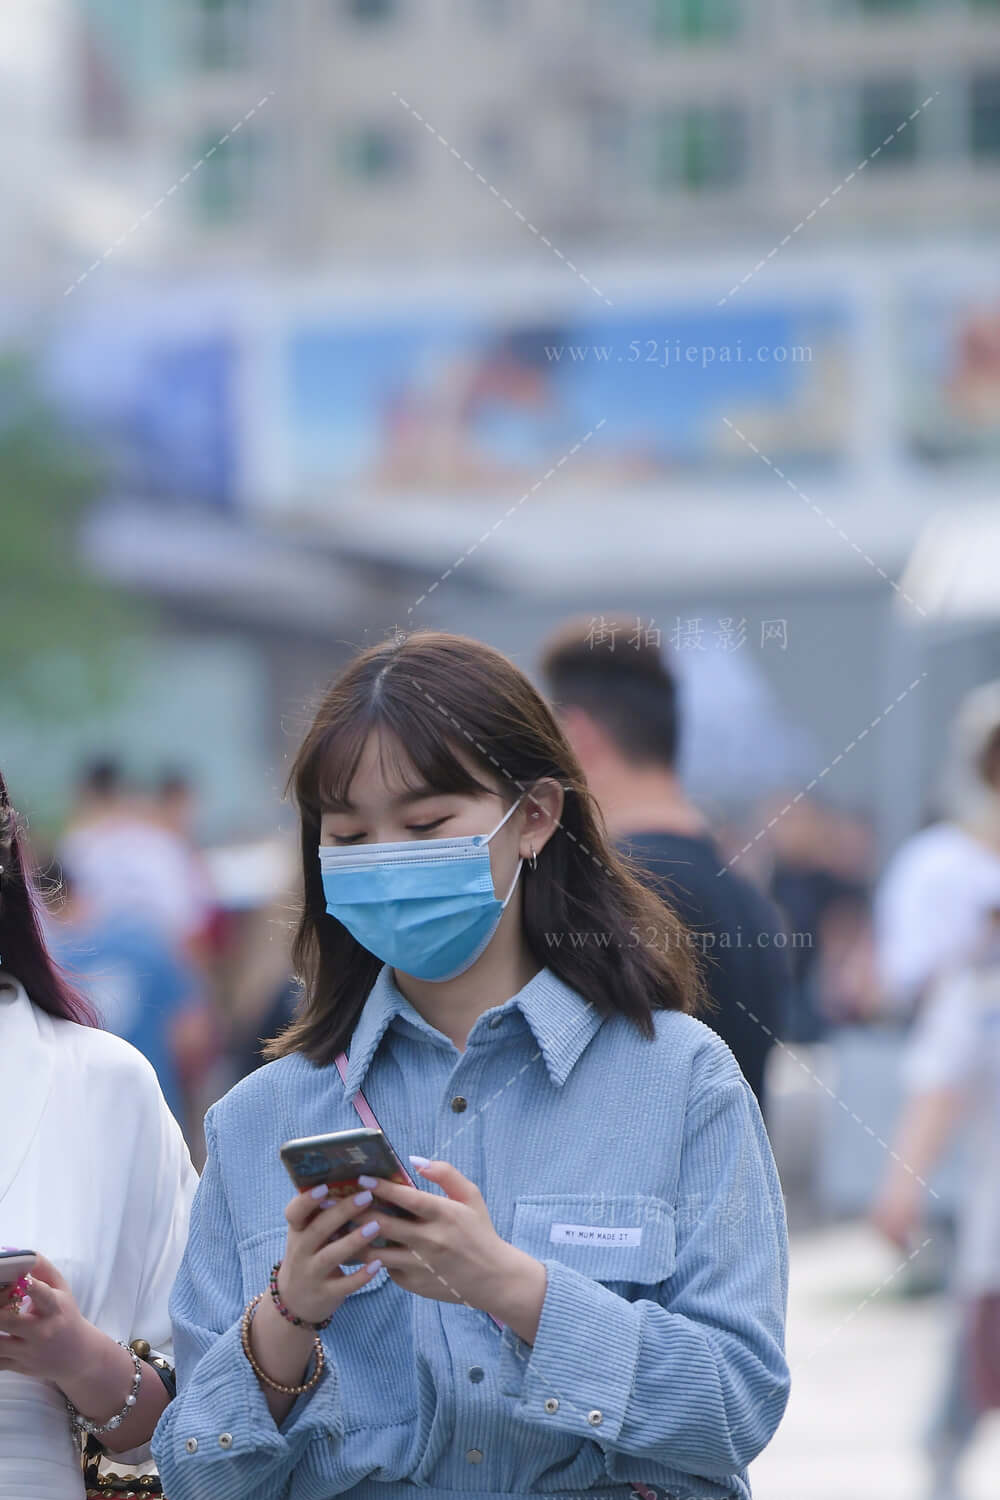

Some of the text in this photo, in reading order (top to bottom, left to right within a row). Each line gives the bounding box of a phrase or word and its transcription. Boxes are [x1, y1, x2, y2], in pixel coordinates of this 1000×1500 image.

[565, 1230, 628, 1241] MY MUM MADE IT
